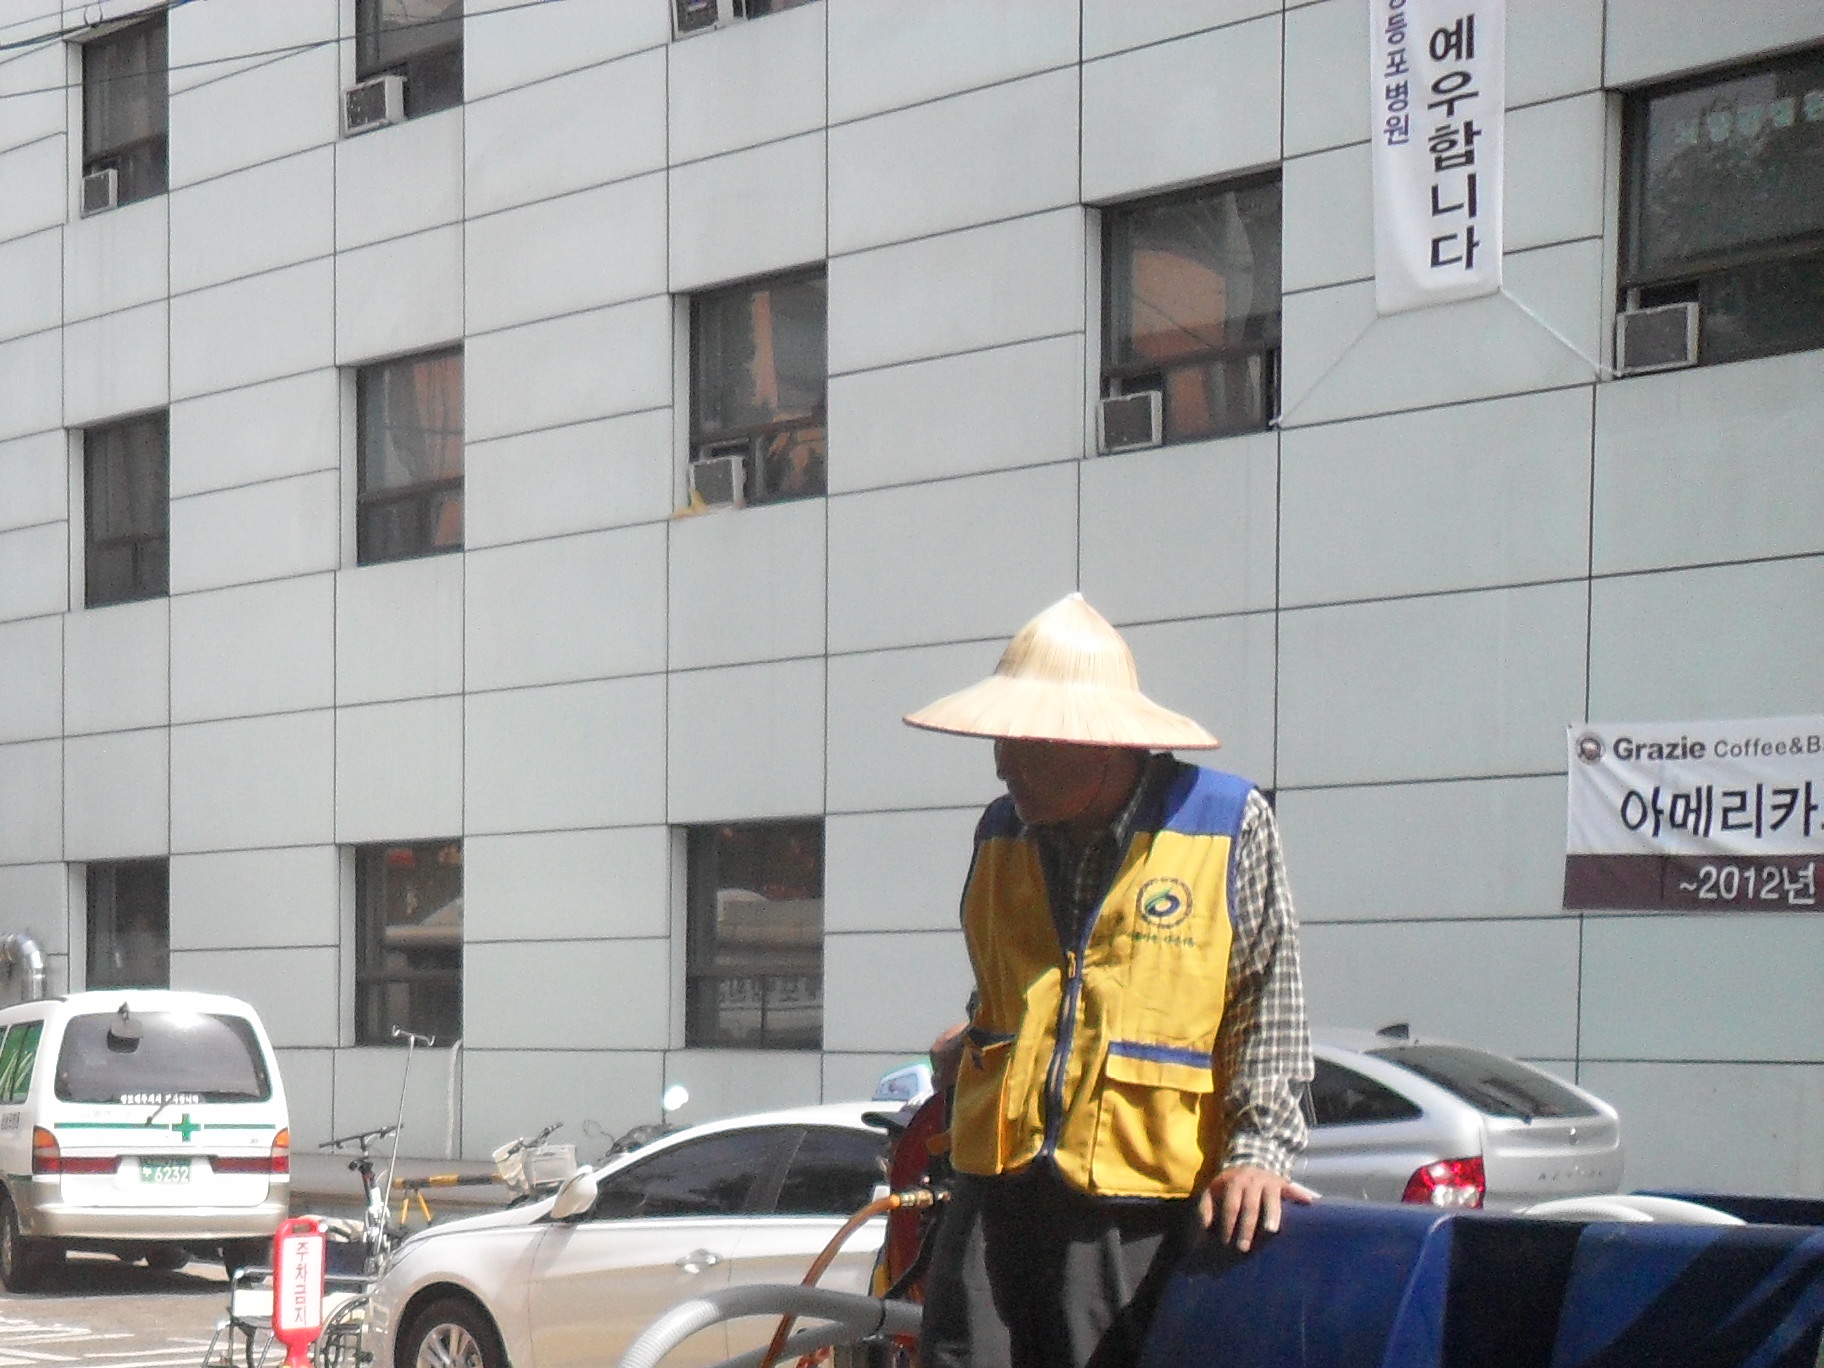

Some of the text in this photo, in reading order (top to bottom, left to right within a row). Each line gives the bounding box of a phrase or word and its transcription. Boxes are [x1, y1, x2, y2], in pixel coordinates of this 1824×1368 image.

[1427, 14, 1482, 271] 예우합니다
[1613, 735, 1824, 761] Grazie Coffee&B
[1620, 780, 1824, 838] 아메리카
[1679, 862, 1816, 905] ~2012년
[154, 1166, 189, 1183] 6232
[293, 1241, 309, 1326] 주차금지
